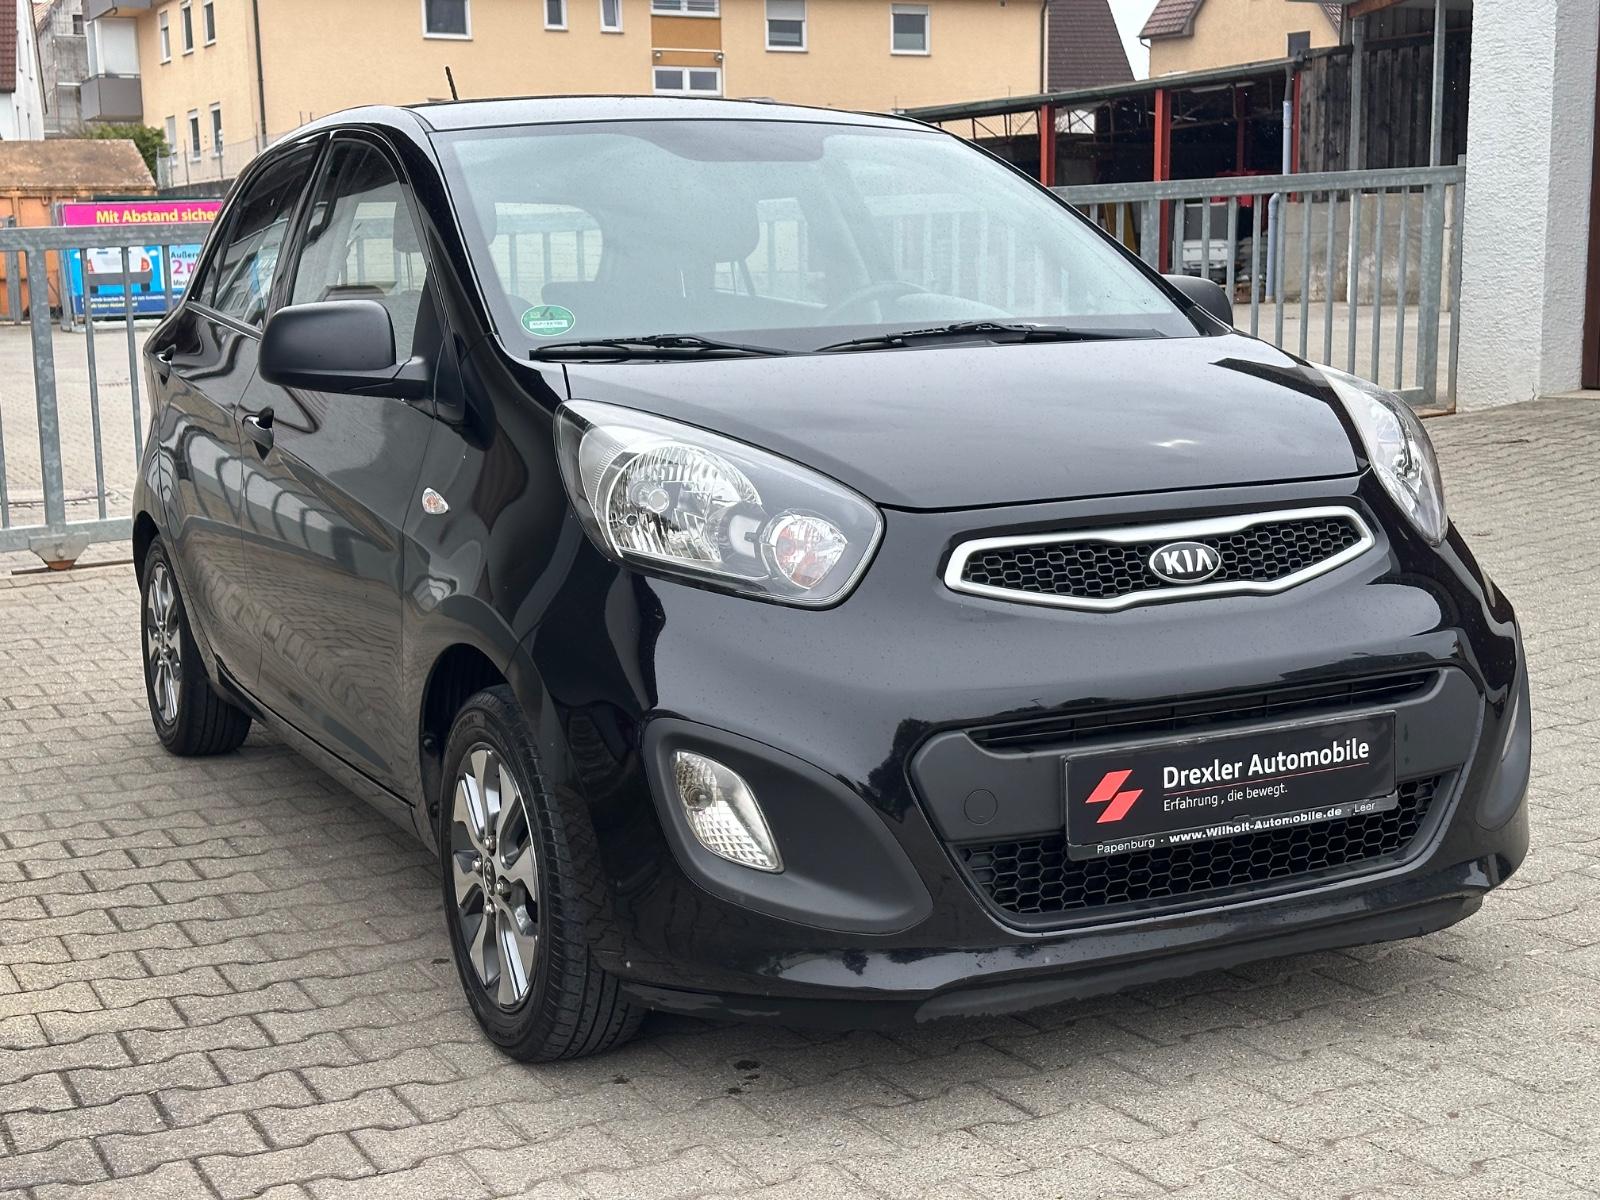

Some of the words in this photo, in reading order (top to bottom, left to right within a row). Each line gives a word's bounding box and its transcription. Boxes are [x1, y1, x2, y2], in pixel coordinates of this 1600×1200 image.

[96, 209, 119, 223] Mit
[122, 208, 178, 222] Abstand
[1160, 548, 1214, 575] KIA
[1163, 758, 1243, 789] Drexler
[1248, 738, 1370, 776] Automobile
[1228, 789, 1244, 802] die
[1247, 783, 1288, 800] bewegt.
[1097, 837, 1155, 854] Papenburg
[1354, 801, 1376, 814] Leer
